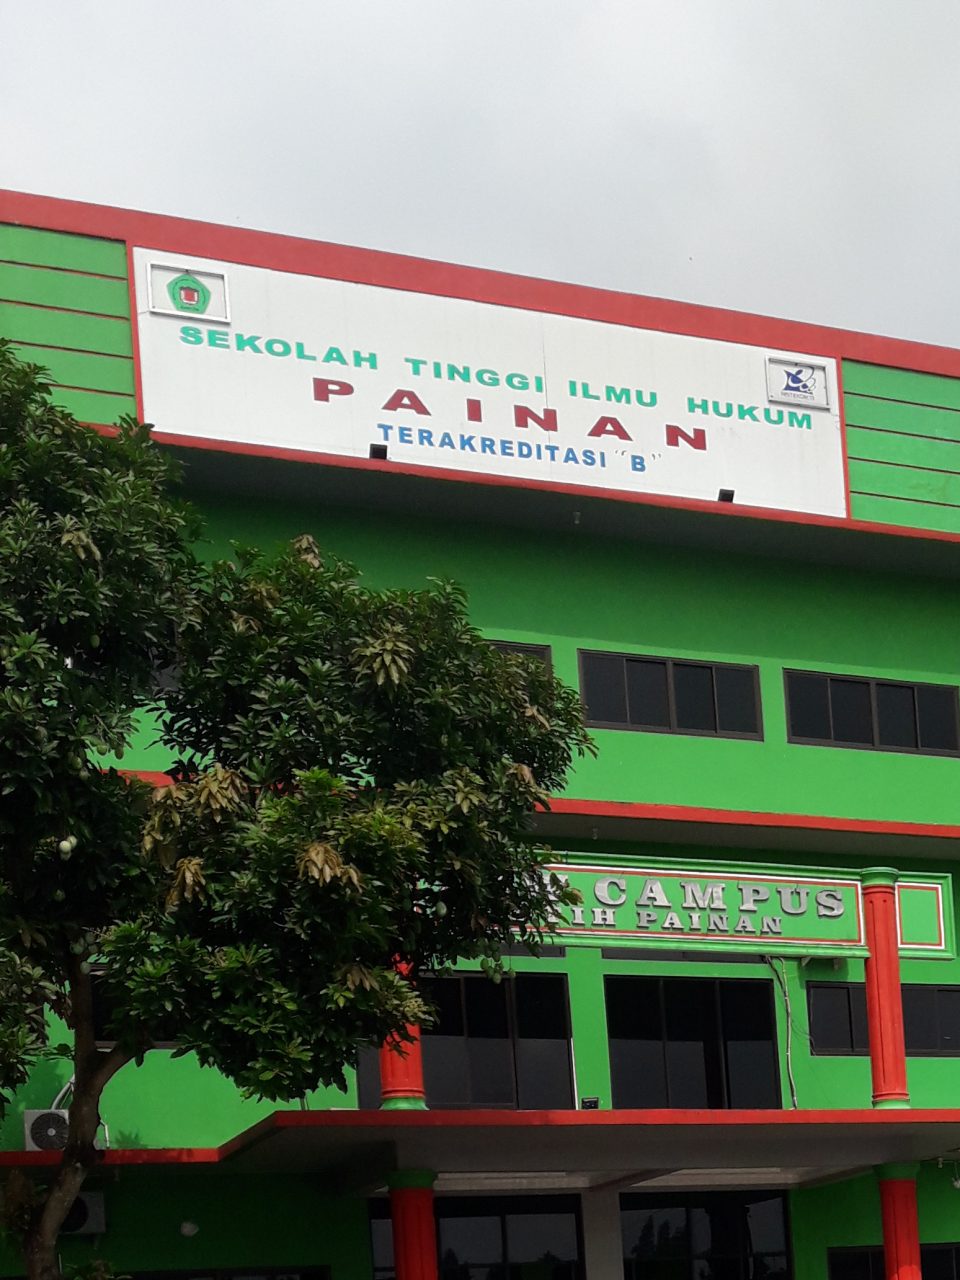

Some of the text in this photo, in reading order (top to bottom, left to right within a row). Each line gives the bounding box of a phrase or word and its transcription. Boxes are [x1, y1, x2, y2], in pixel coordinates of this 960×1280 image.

[179, 325, 813, 430] SEKOLAH TINGGI ILMU HUKUM
[312, 376, 708, 451] PAINAN
[377, 423, 606, 469] TERAKREDITASI
[592, 876, 846, 918] CAMPUS
[637, 911, 783, 935] PAINAN
